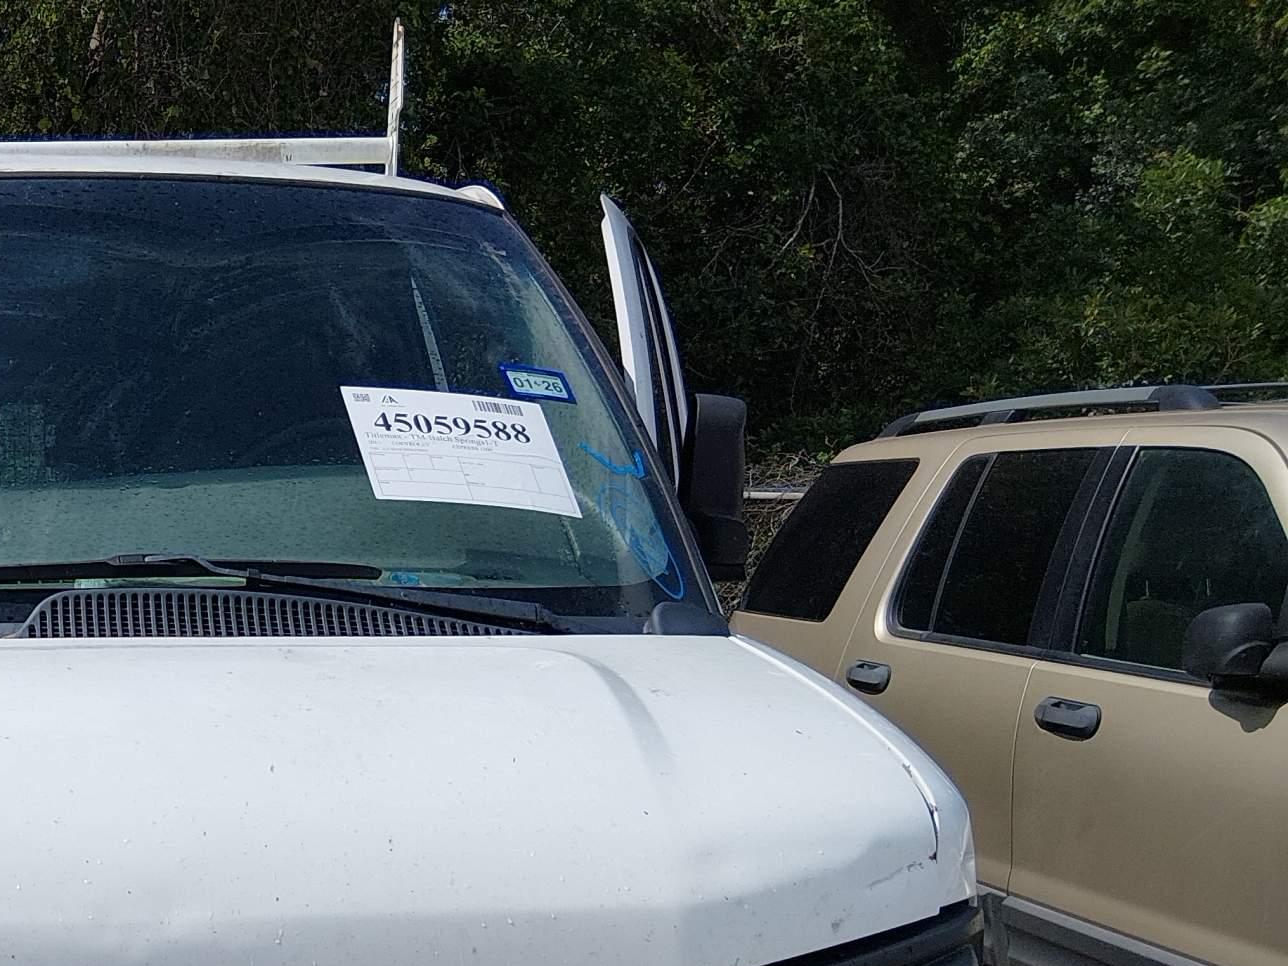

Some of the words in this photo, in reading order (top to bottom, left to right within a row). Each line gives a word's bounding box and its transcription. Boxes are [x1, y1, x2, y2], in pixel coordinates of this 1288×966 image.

[513, 377, 533, 389] 01
[542, 380, 563, 393] 26
[374, 411, 531, 444] 45059588
